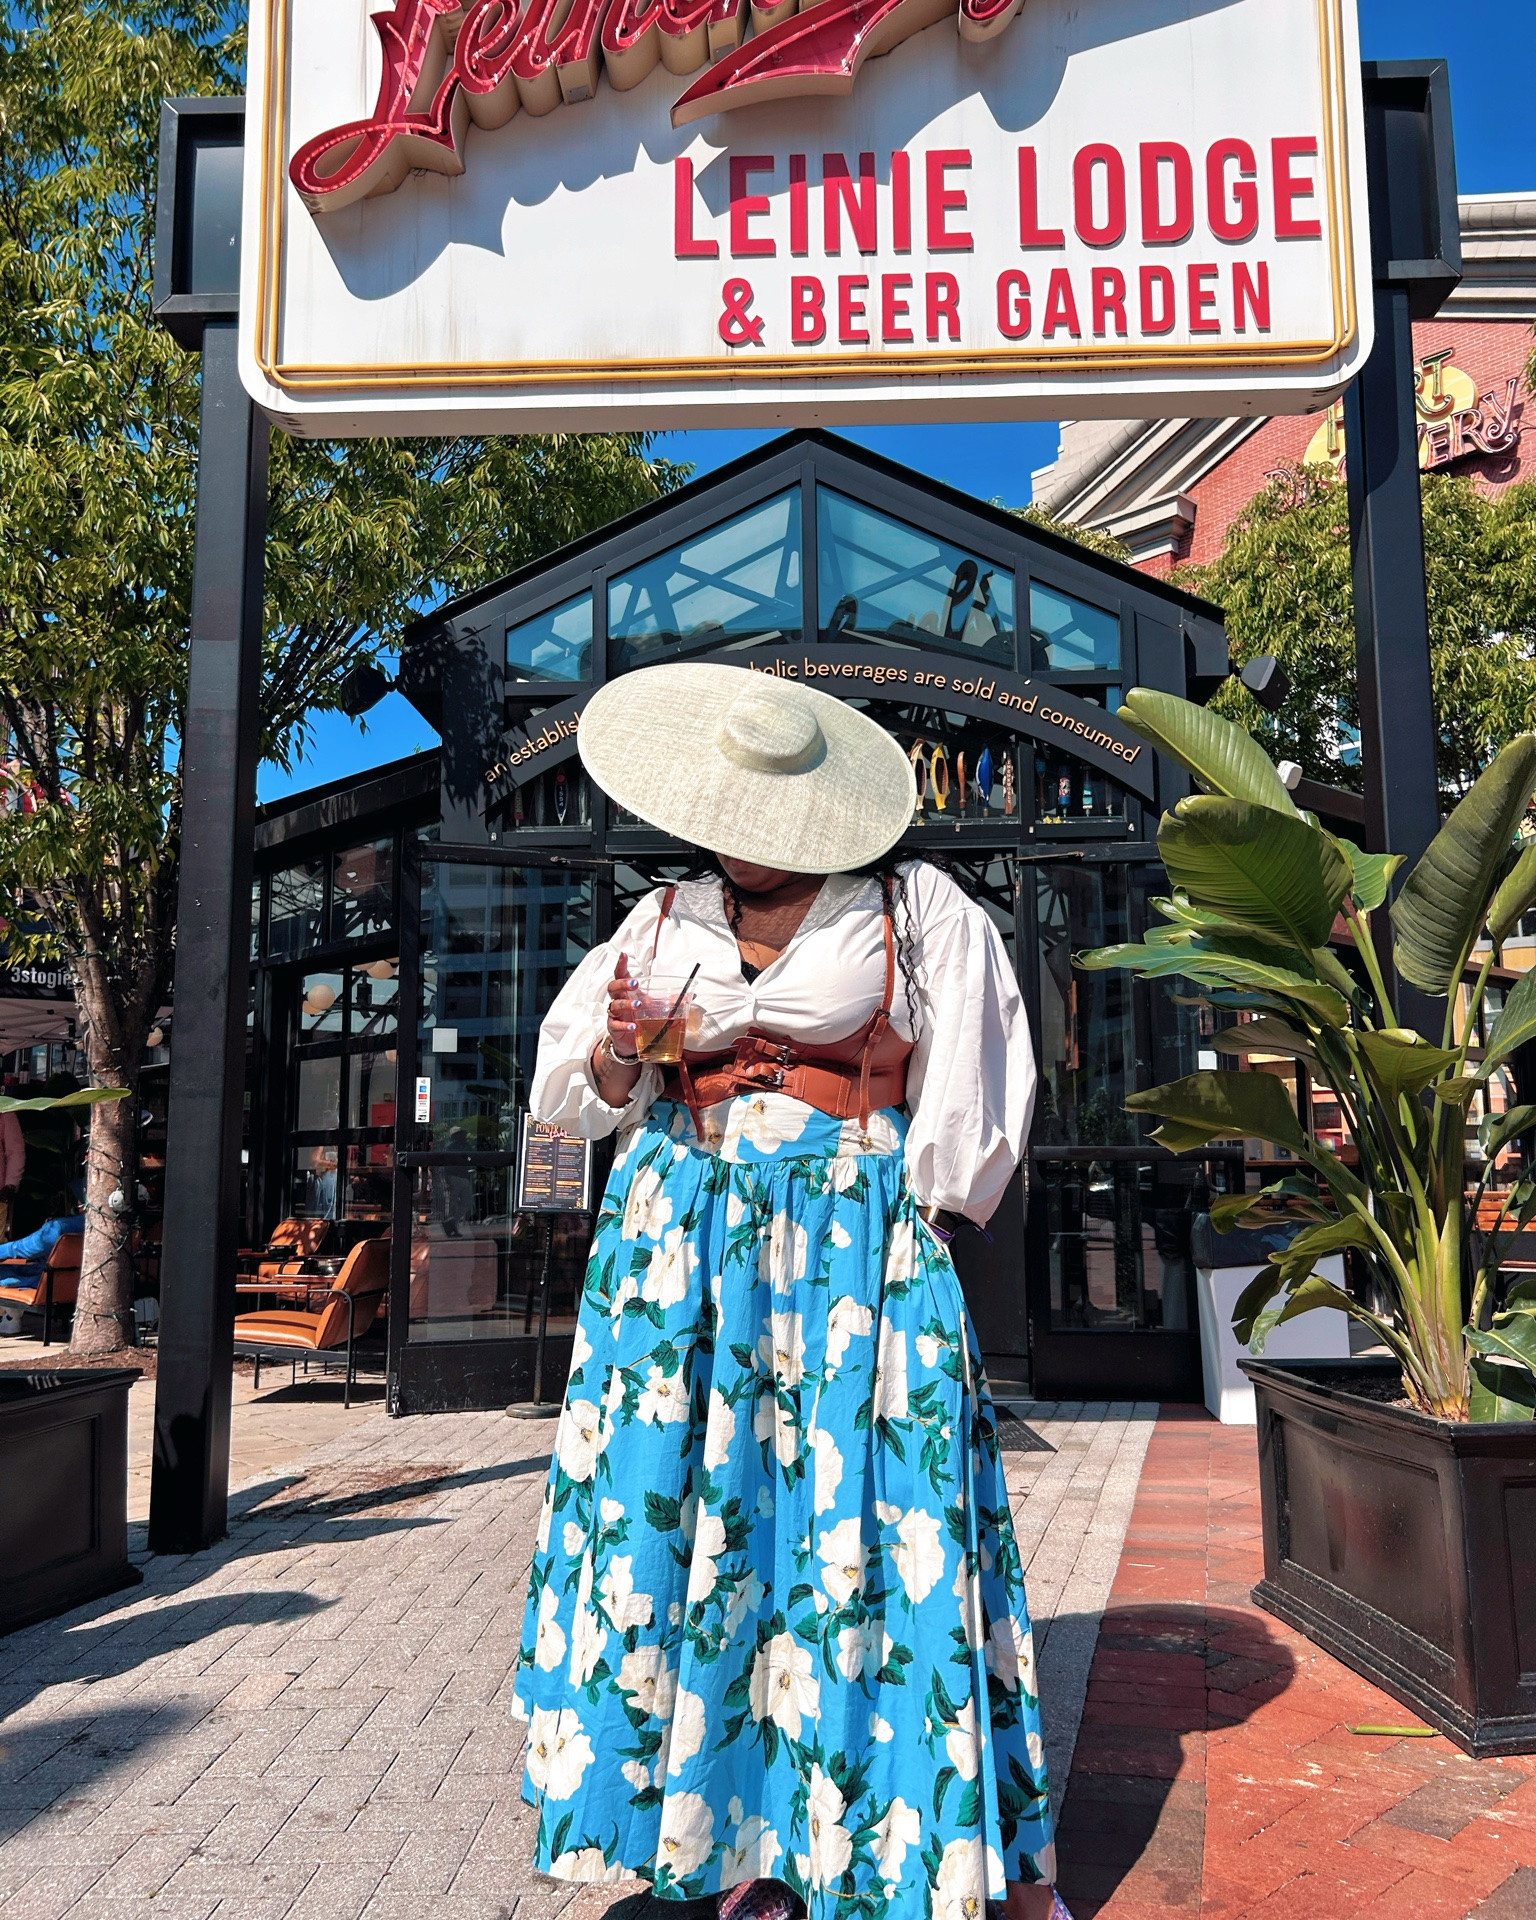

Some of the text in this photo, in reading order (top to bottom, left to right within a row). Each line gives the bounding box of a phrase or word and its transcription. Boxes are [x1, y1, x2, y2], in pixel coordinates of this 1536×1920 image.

[675, 135, 1322, 258] LEINIE LODGE
[717, 260, 1271, 346] & BEER GARDEN
[485, 762, 508, 782] an
[804, 657, 908, 684] beverages
[913, 670, 946, 688] are
[951, 677, 996, 699] sold
[998, 695, 1039, 714] and
[1039, 705, 1141, 763] consumed
